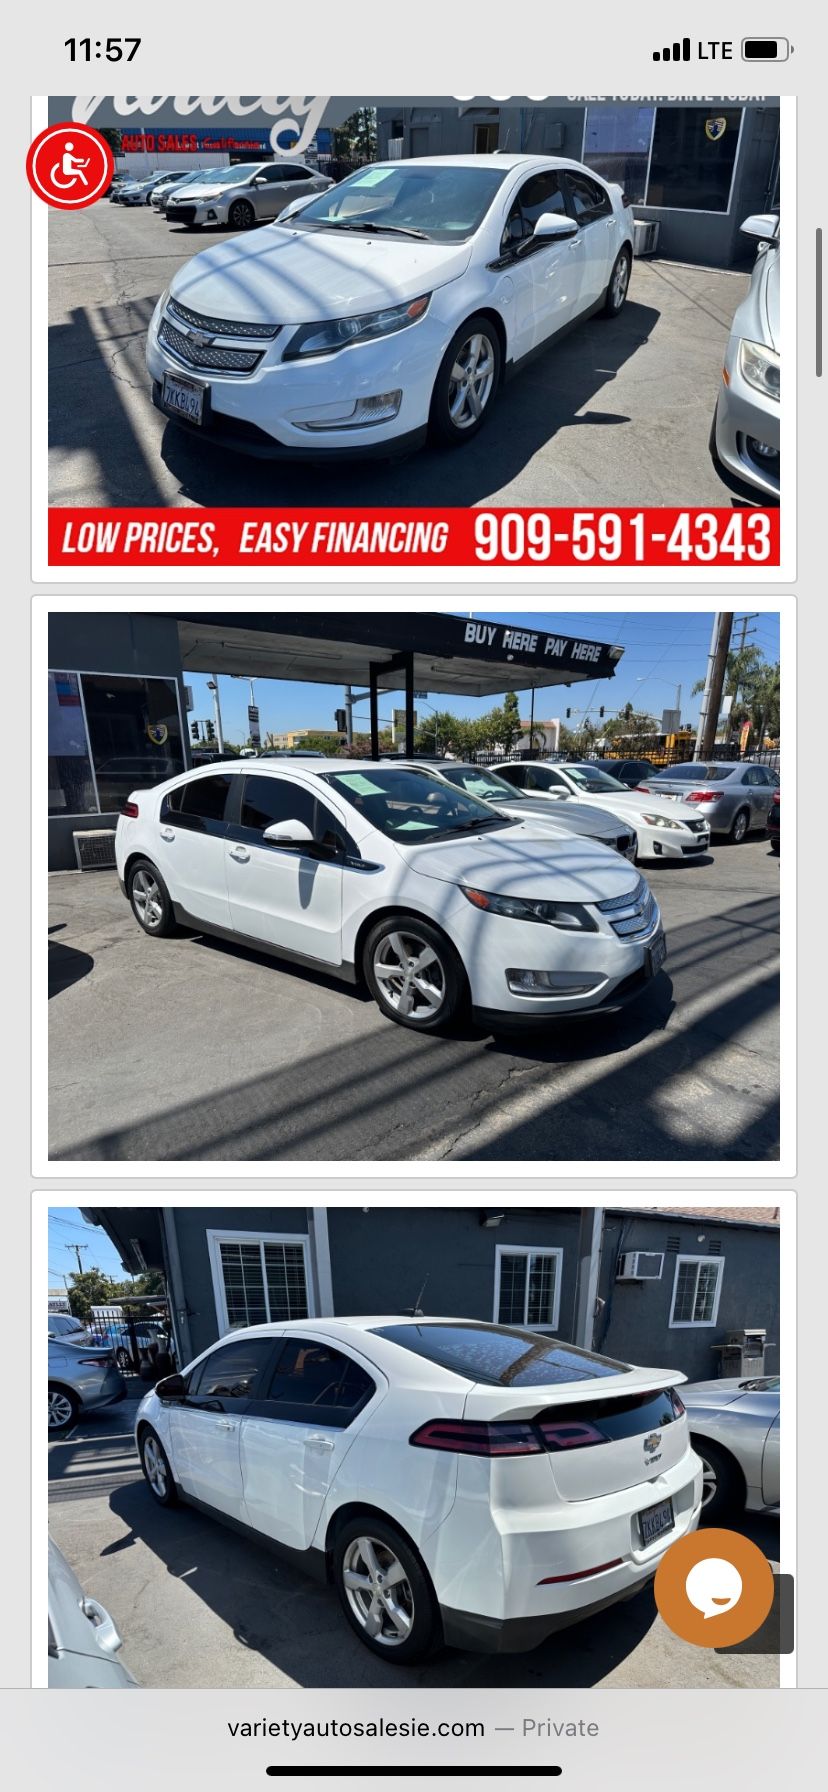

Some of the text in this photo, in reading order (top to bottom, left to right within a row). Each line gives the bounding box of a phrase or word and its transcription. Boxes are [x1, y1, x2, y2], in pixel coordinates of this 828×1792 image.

[64, 38, 142, 62] 11:57
[698, 41, 733, 60] LTE
[463, 622, 603, 663] BUY HERE PAY HERE
[227, 1717, 486, 1741] varietyautosalesie.com
[521, 1718, 600, 1738] Private
